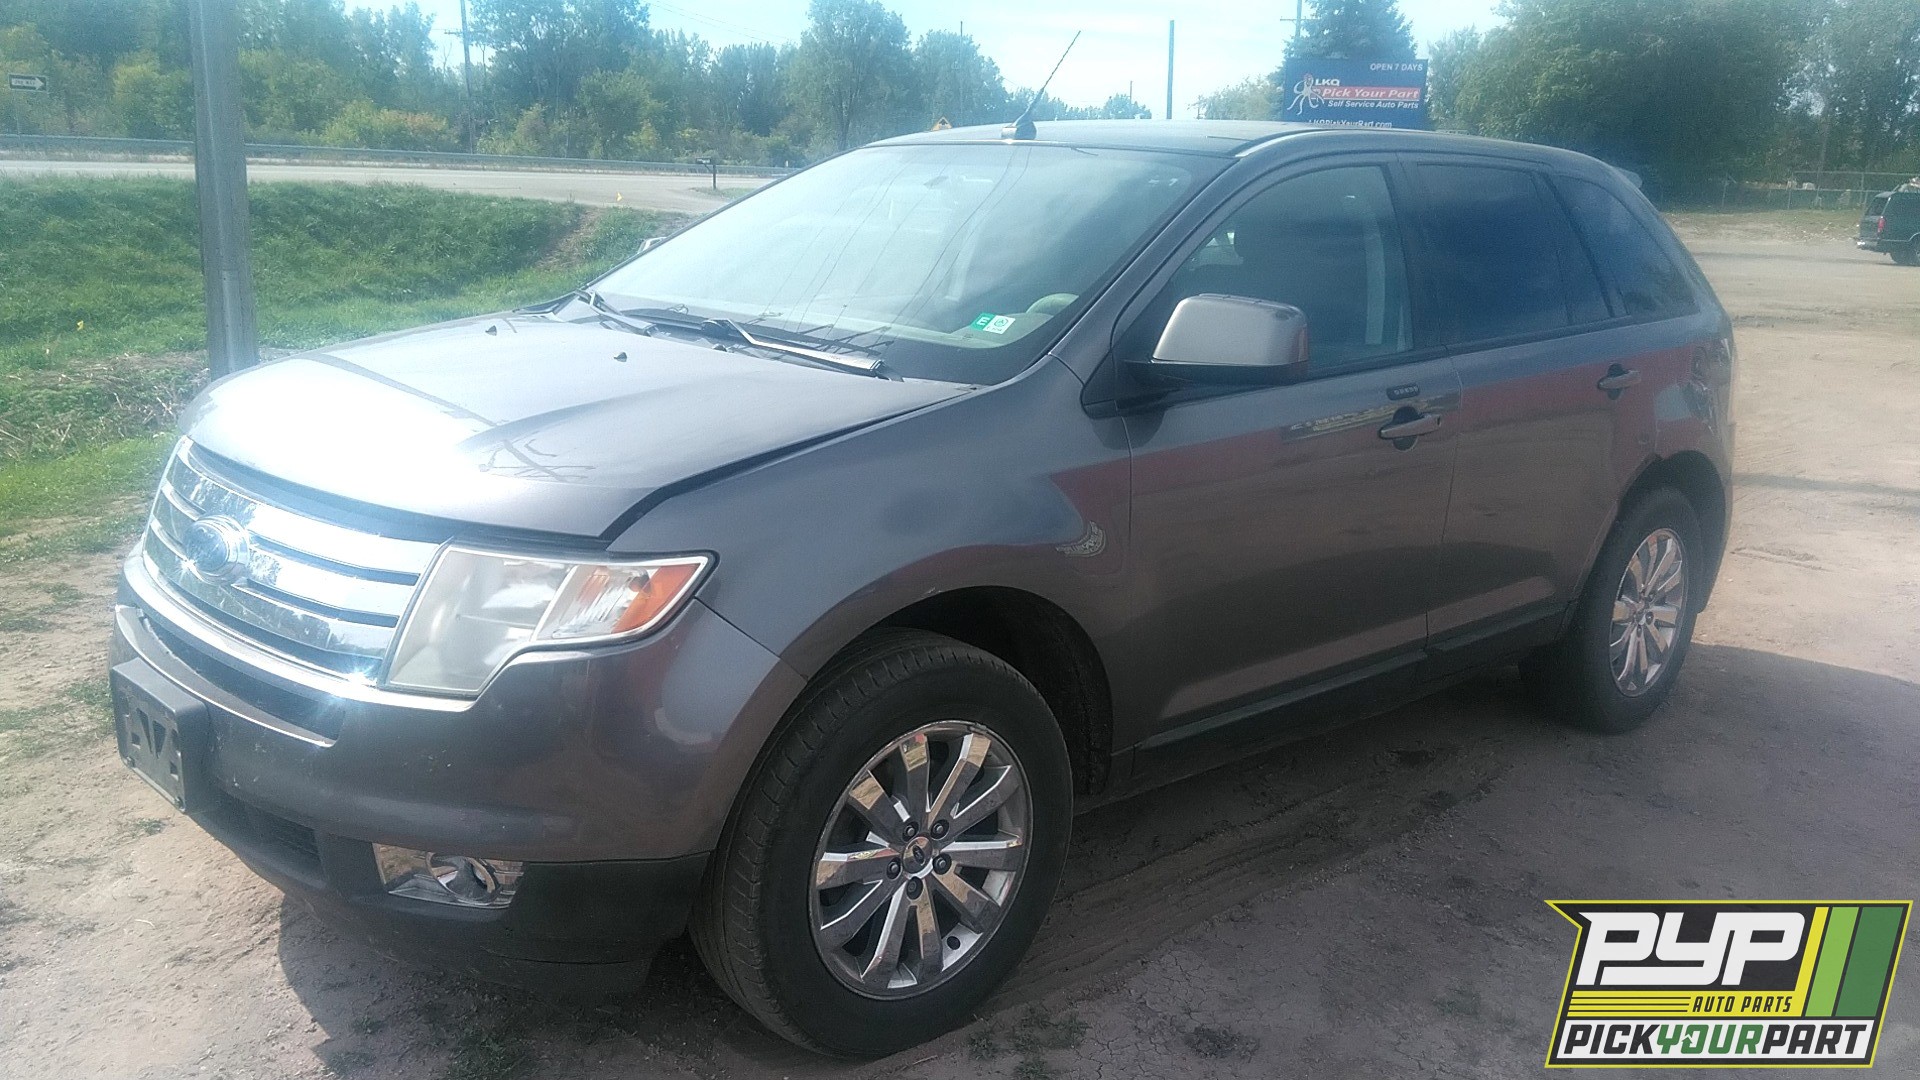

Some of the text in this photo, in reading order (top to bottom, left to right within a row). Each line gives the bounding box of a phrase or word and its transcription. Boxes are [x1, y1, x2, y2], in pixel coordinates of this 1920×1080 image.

[1370, 63, 1423, 71] OPEN 7 DAYS
[1315, 78, 1340, 87] LKQ
[1322, 88, 1419, 99] Pick Your Part
[1328, 100, 1344, 108] Self
[1345, 100, 1376, 108] Service
[1397, 101, 1419, 109] Parts
